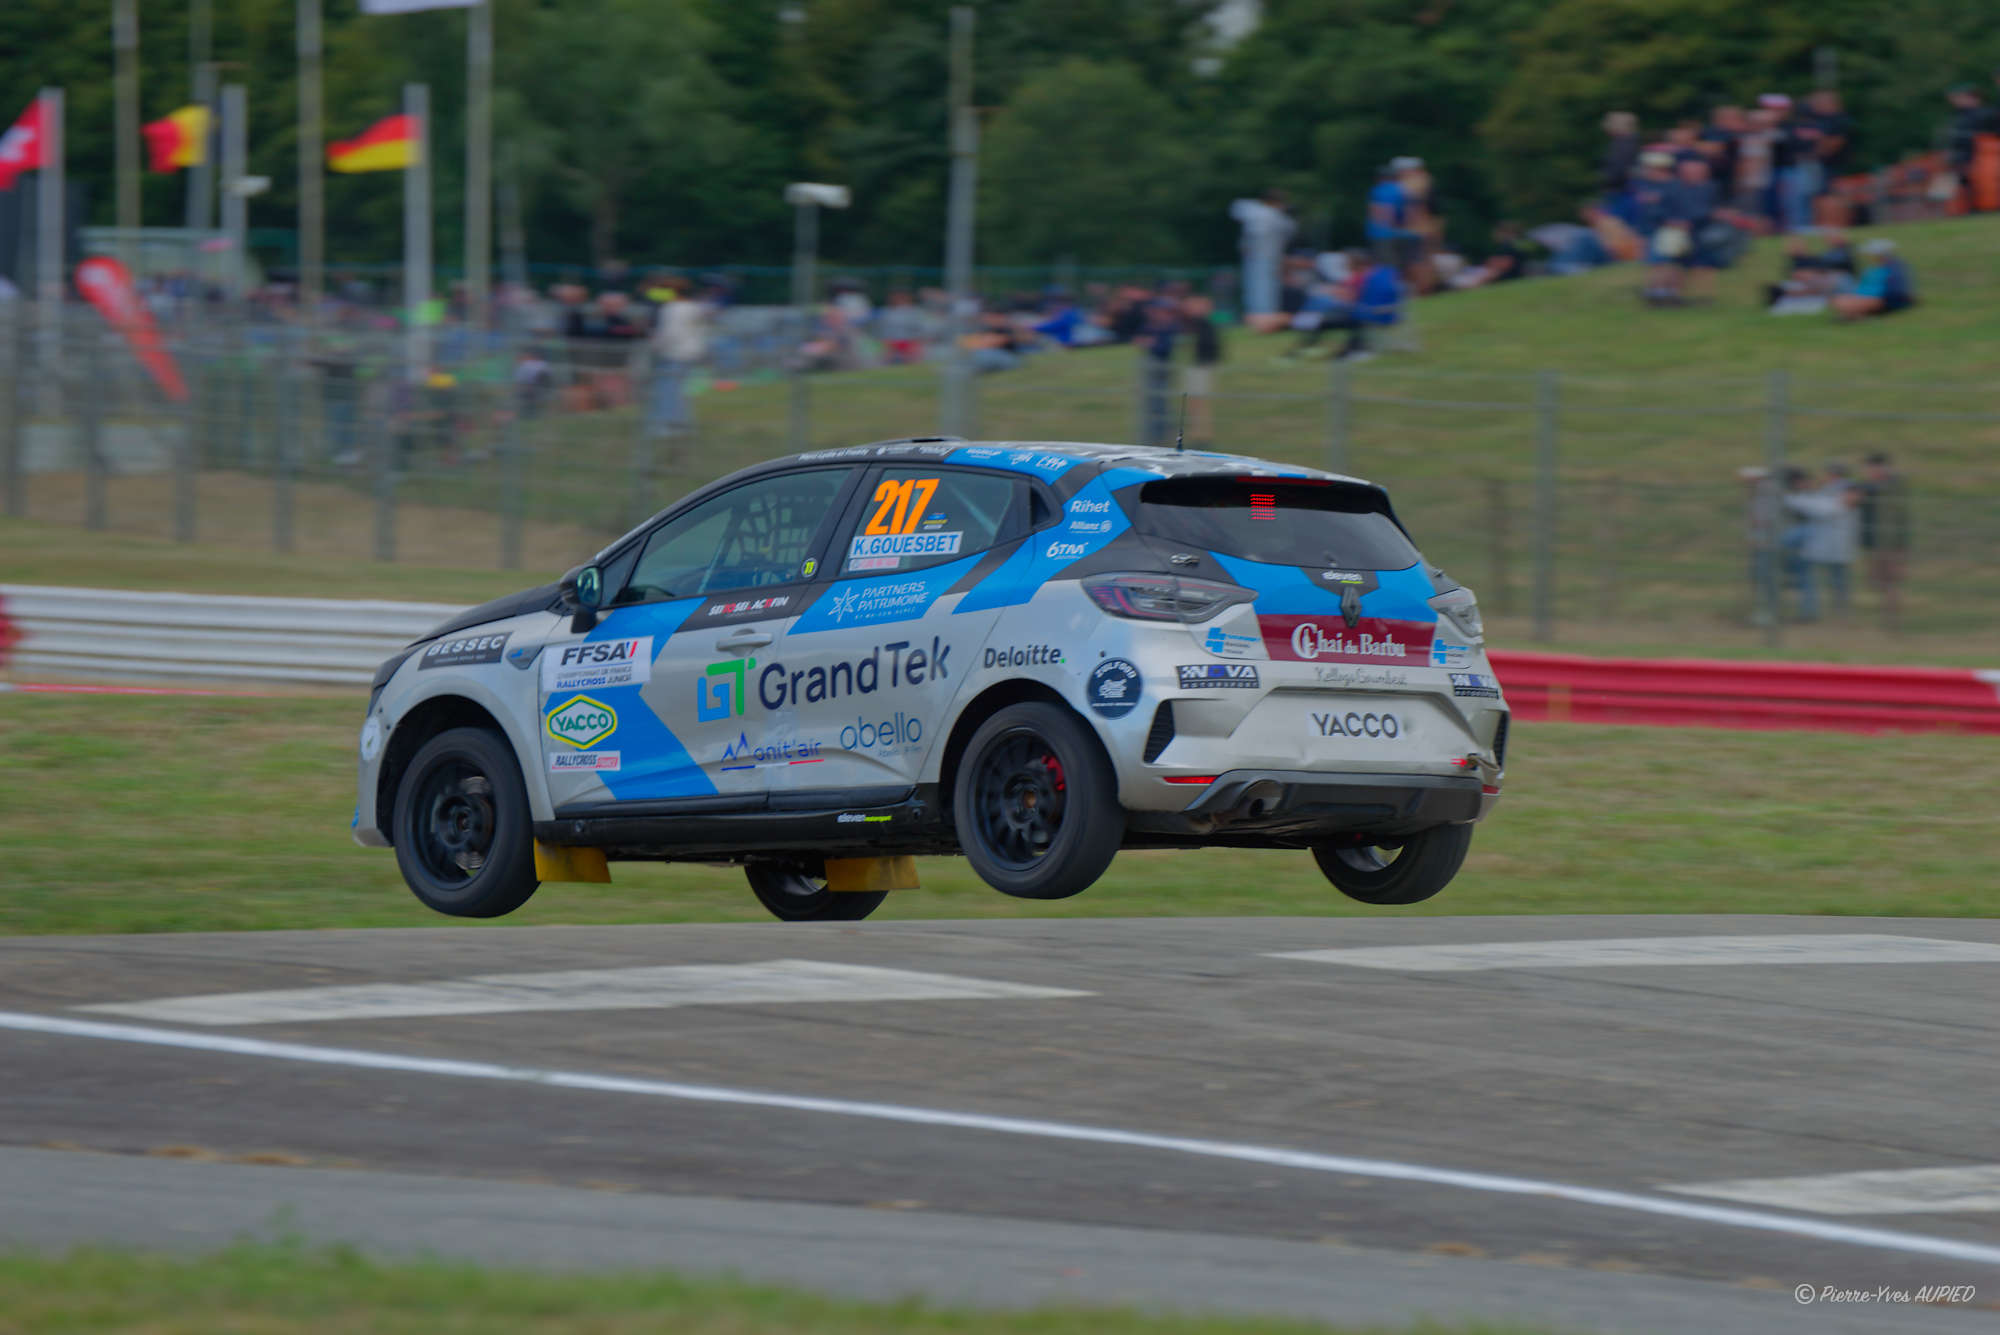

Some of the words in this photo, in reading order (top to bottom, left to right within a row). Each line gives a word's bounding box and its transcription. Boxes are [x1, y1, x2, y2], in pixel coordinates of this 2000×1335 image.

[864, 478, 940, 536] 217
[1069, 500, 1110, 513] Rihet
[1069, 521, 1099, 531] Allianz
[853, 534, 960, 556] K.GOUESBET
[861, 580, 926, 599] PARTNERS
[857, 591, 930, 612] PATRIMOINE
[425, 635, 505, 657] BESSEC
[1291, 622, 1343, 659] Chai
[1359, 633, 1406, 657] Barbu
[560, 642, 628, 666] FFSA
[556, 676, 606, 689] RALLYCROSS
[758, 635, 951, 710] GrandTek
[555, 712, 609, 733] YACCO
[840, 712, 923, 751] abello
[1312, 712, 1399, 739] YACCO
[555, 754, 598, 767] RALLYCROSS
